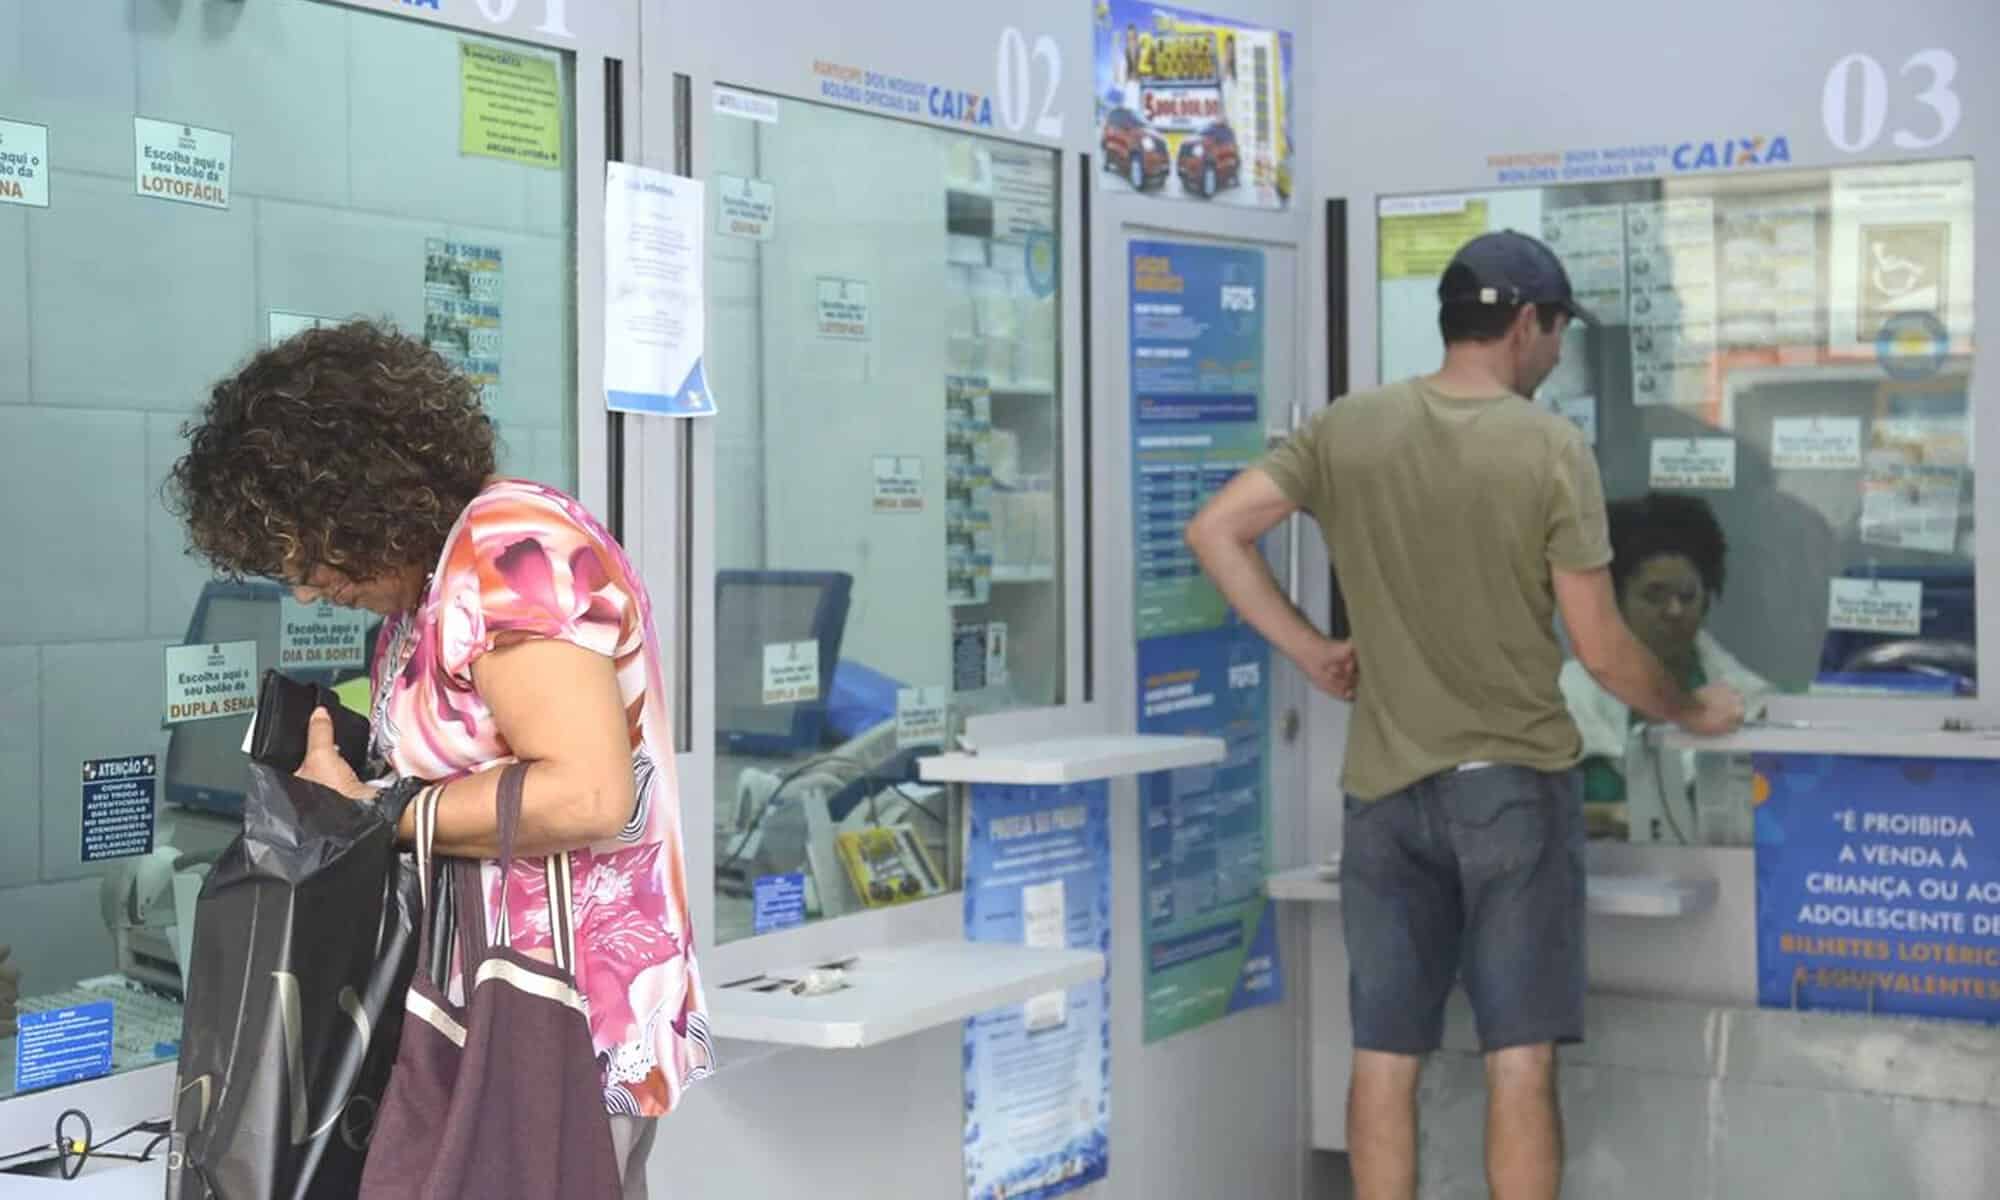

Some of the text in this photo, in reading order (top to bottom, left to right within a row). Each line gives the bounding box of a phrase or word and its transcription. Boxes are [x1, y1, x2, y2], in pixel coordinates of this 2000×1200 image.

[997, 26, 1063, 138] 02
[928, 86, 992, 126] CAIXA
[1822, 48, 1961, 152] 03
[0, 151, 39, 166] aqui o
[144, 145, 224, 171] Escolha aqui o
[1672, 136, 1791, 171] CAIXA
[18, 165, 33, 177] da
[151, 161, 219, 181] seu bolão da
[287, 623, 328, 635] Escolha
[293, 636, 310, 645] seu
[283, 649, 302, 662] DIA
[178, 669, 220, 685] Escolha
[222, 669, 244, 682] aqui
[184, 684, 201, 696] seu
[206, 682, 231, 696] bolão
[170, 697, 257, 719] DUPLA SENA
[99, 758, 141, 777] ATENÇÃO
[1863, 812, 1975, 838] PROIBIDA
[1838, 843, 1857, 864] A
[1861, 844, 1944, 868] VENDA
[1806, 872, 1911, 901] CRIANÇA
[1919, 878, 1959, 902] OU
[1797, 903, 1965, 934] ADOLESCENTE
[1780, 933, 1889, 961] BILHETES
